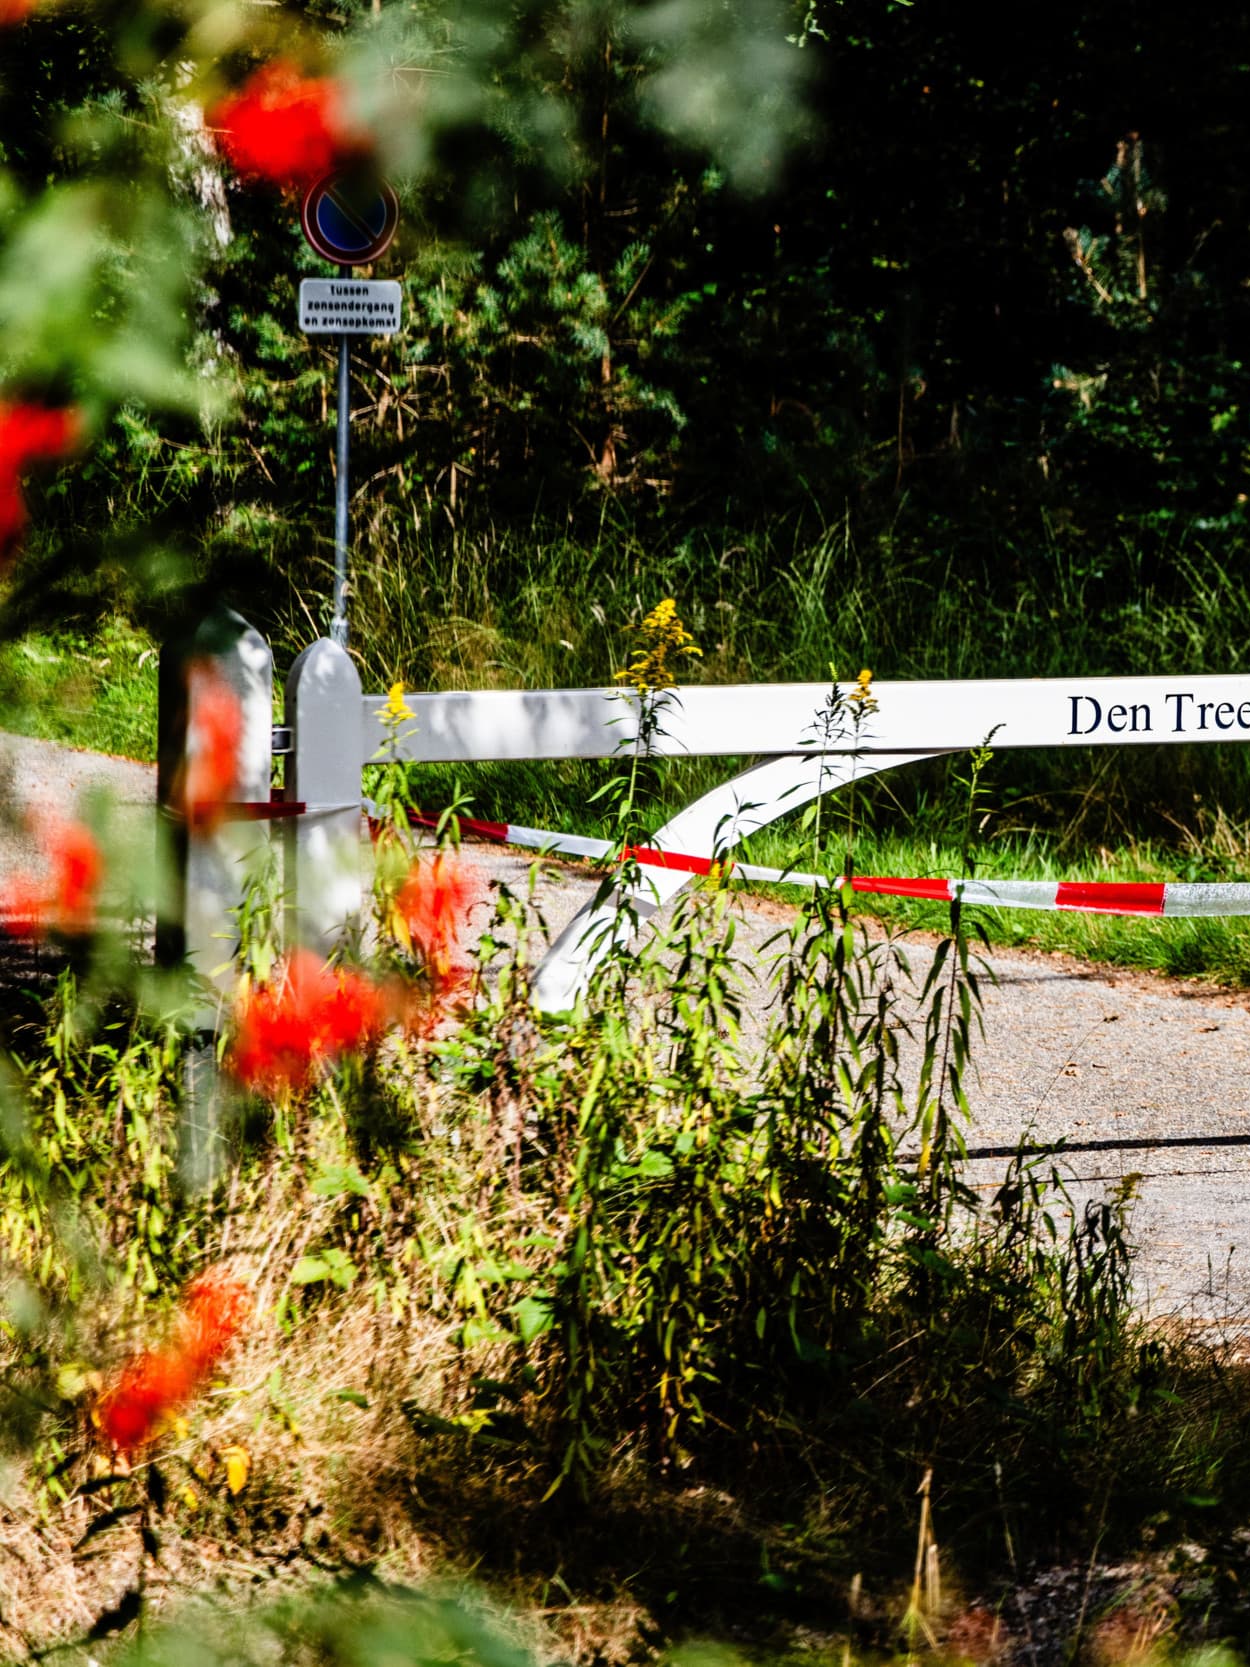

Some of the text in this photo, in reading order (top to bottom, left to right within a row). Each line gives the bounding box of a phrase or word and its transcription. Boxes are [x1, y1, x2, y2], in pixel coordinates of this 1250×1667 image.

[330, 284, 369, 296] tussen
[307, 301, 394, 315] zonsondergang
[304, 317, 396, 328] en zonsopkomst
[1067, 696, 1153, 735] Den
